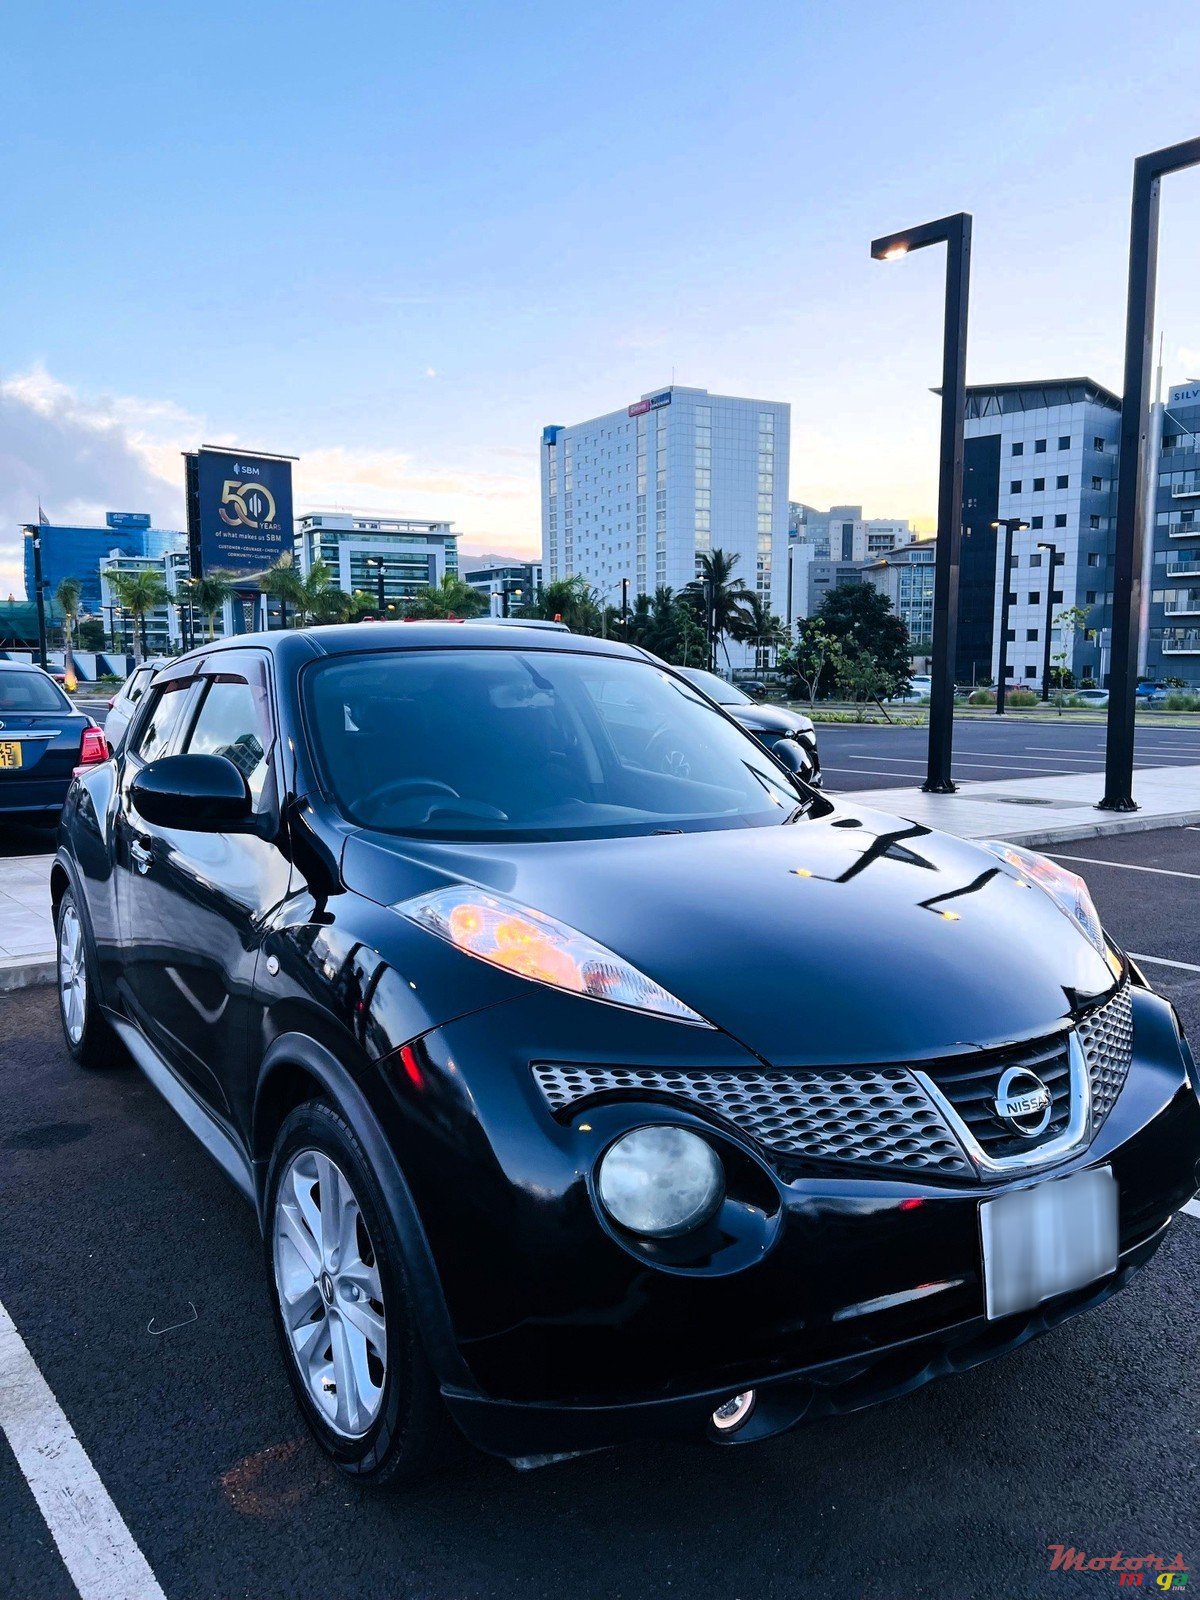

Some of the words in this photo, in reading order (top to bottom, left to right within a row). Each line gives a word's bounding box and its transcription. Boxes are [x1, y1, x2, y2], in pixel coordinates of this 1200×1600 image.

[1174, 389, 1200, 401] SILV
[241, 466, 260, 475] SBM
[219, 480, 276, 528] 50
[260, 522, 281, 530] YEARS
[266, 533, 282, 542] SBM
[1006, 1094, 1048, 1113] NISSAN
